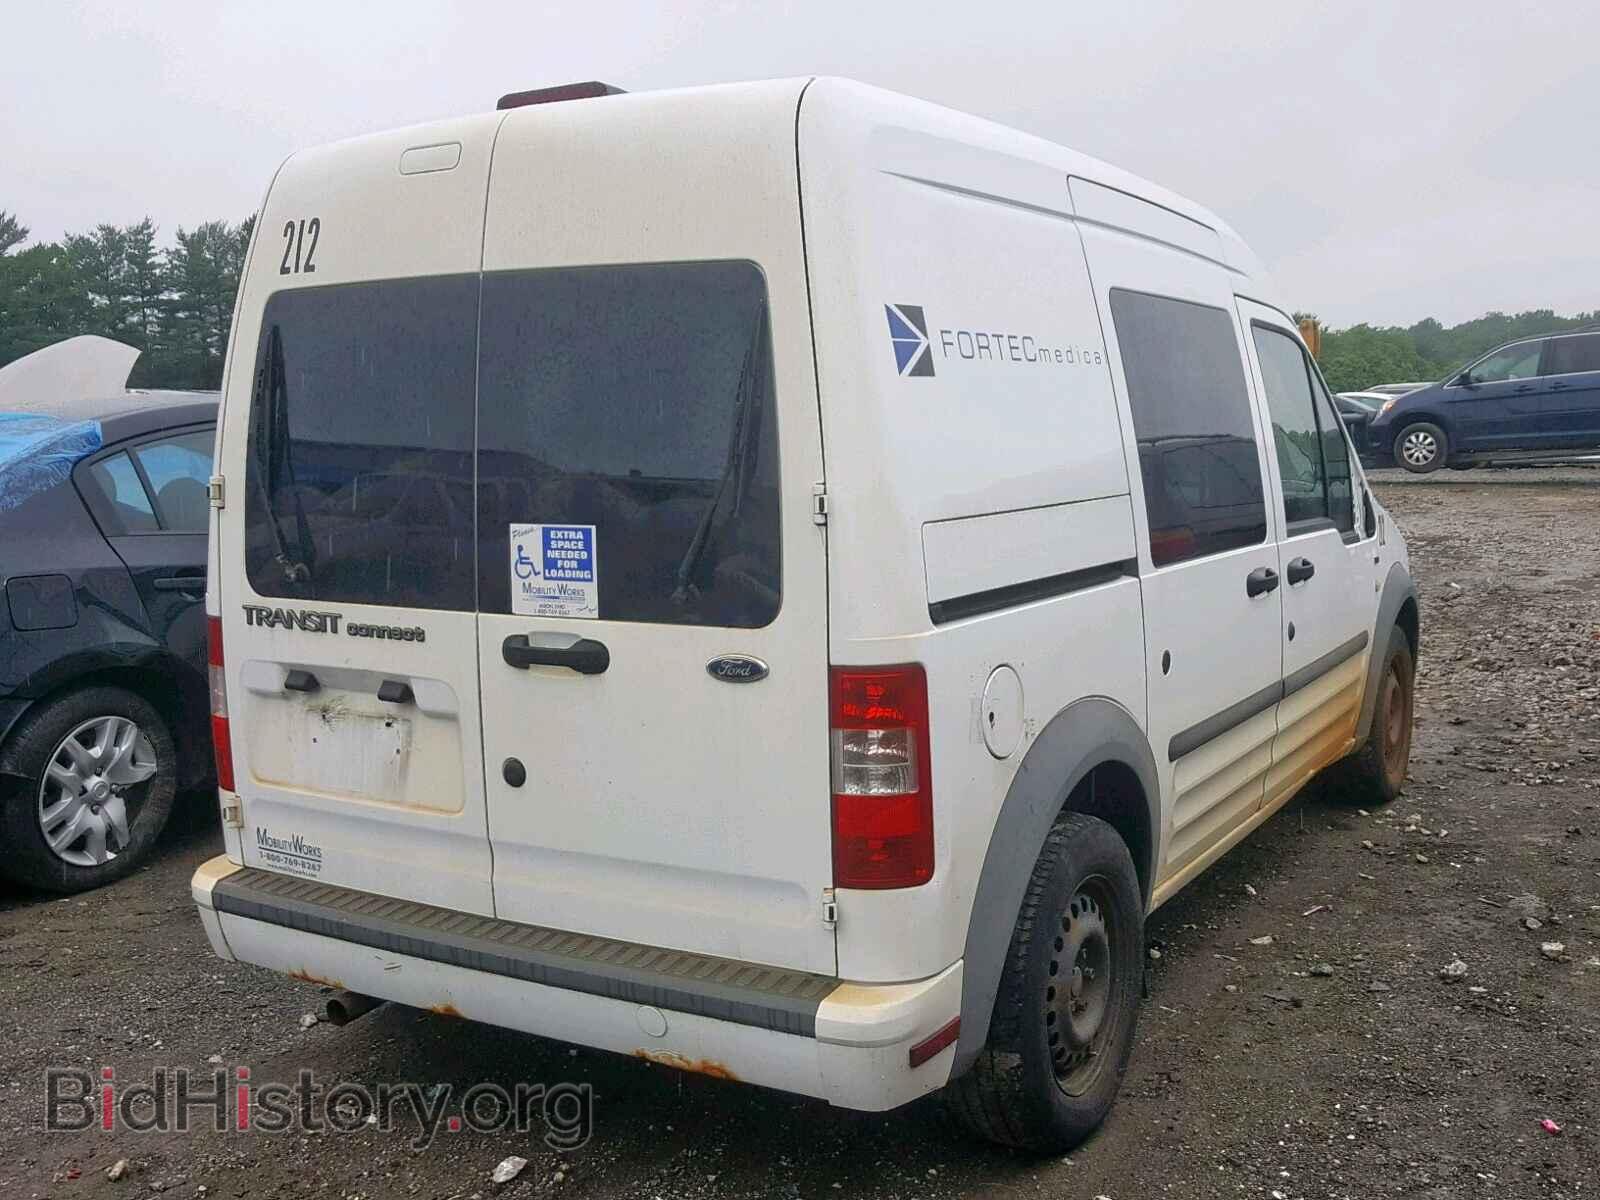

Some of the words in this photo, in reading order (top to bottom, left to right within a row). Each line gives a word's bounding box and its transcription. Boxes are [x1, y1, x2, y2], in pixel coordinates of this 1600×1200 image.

[280, 217, 320, 275] 212
[550, 530, 584, 540] EXTRA
[550, 540, 585, 550] SPACE
[547, 550, 588, 559] NEEDED
[557, 560, 578, 569] FOR
[545, 569, 592, 579] LOADING
[242, 604, 342, 634] TRANSIT
[346, 622, 426, 642] connect
[720, 659, 752, 677] Ford
